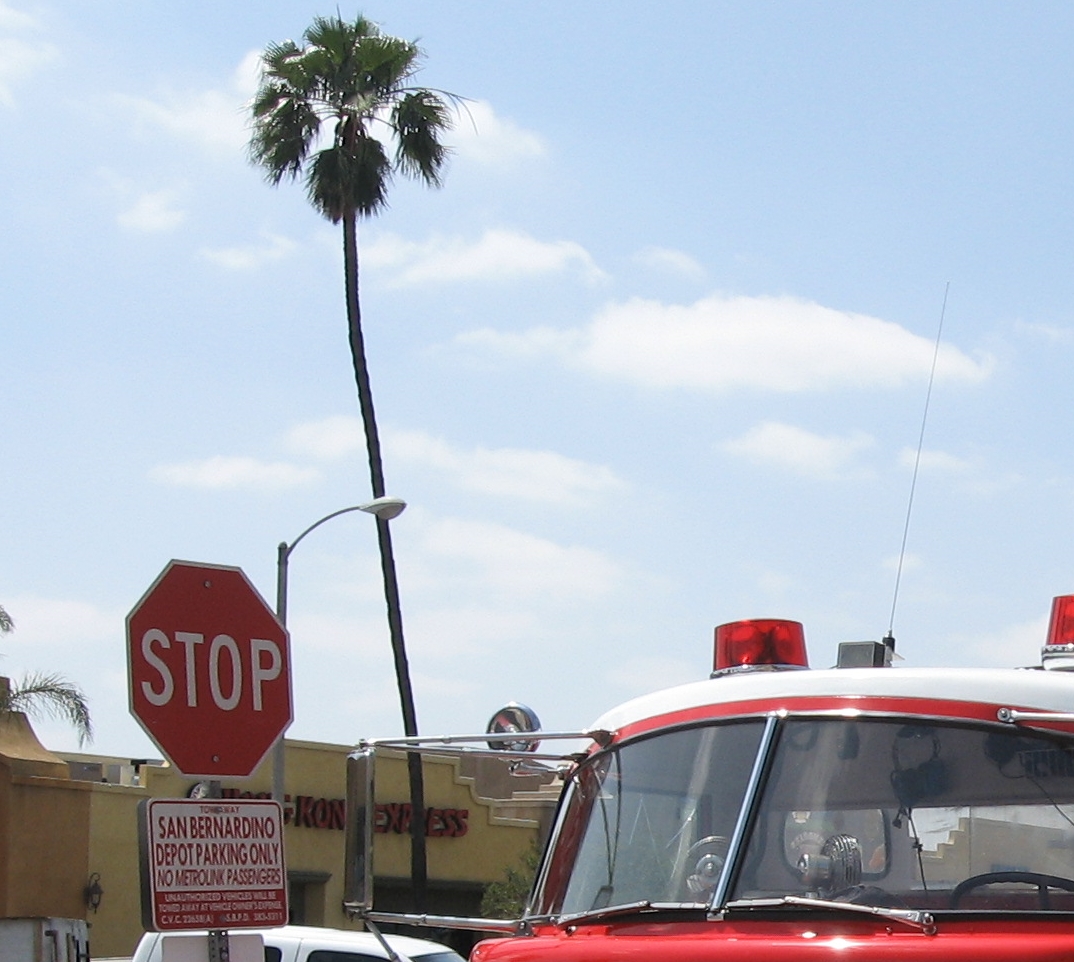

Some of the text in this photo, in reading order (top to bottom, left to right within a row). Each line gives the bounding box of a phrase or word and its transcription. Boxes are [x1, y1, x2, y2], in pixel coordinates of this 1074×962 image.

[141, 628, 282, 711] STOP
[158, 815, 275, 839] SAN BERNARDINO
[296, 796, 346, 830] KON
[373, 803, 469, 837] EXPESS
[156, 842, 279, 866] DEPOT PARKING ONLY
[157, 867, 281, 887] NO METROLINK PASSENGERS
